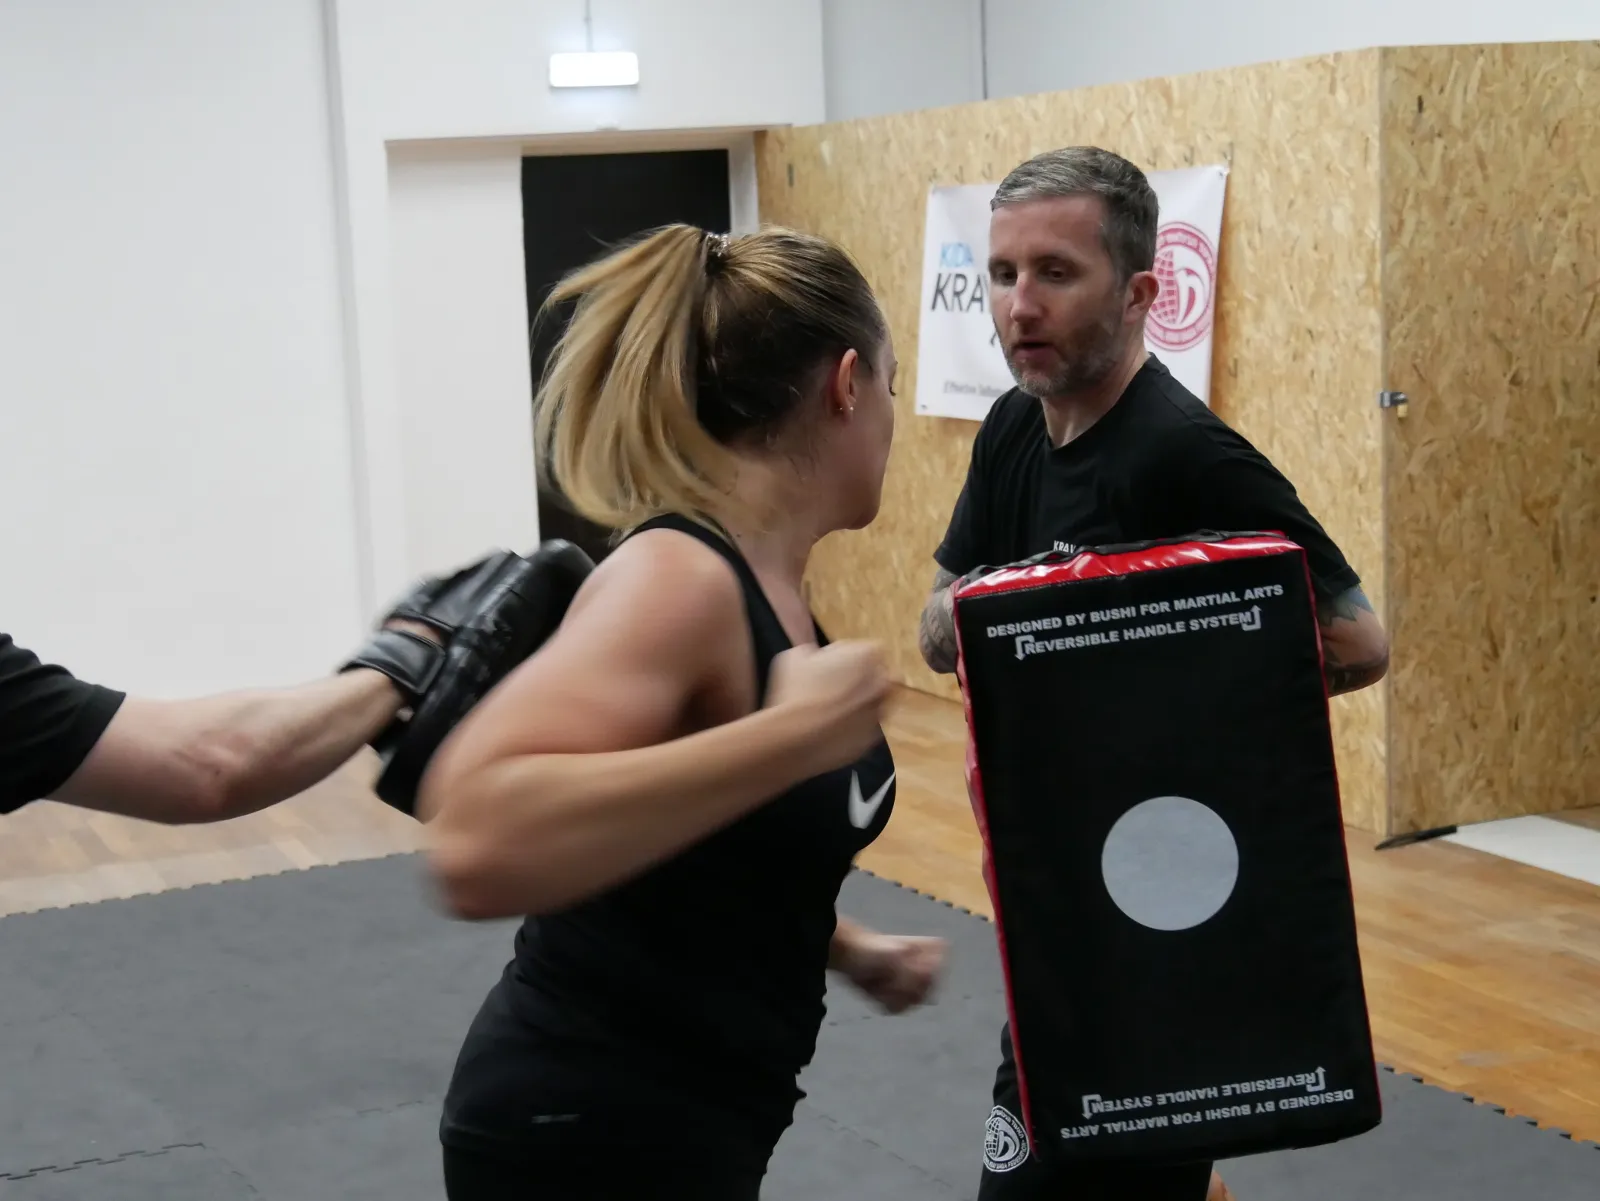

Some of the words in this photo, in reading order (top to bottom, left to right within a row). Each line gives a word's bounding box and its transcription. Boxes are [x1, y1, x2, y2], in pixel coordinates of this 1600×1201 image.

[986, 617, 1062, 638] DESIGNED
[1065, 613, 1086, 626] BY
[1090, 606, 1137, 623] BUSHI
[1140, 601, 1171, 616] FOR
[1173, 591, 1241, 611] MARTIAL
[1244, 584, 1284, 600] ARTS
[1024, 630, 1120, 655] REVERSIBLE
[1123, 621, 1187, 640] HANDLE
[1189, 611, 1251, 631] SYSTEM
[1221, 1072, 1316, 1096] REVERSIBLE
[1091, 1095, 1153, 1114] SYSTEM
[1156, 1086, 1218, 1106] HANDLE
[1279, 1089, 1354, 1110] DESIGNED
[1205, 1104, 1251, 1121] BUSHI
[1255, 1101, 1276, 1114] BY
[1102, 1116, 1169, 1134] MARTIAL
[1171, 1111, 1202, 1125] FOR
[1060, 1124, 1100, 1139] ARTS
